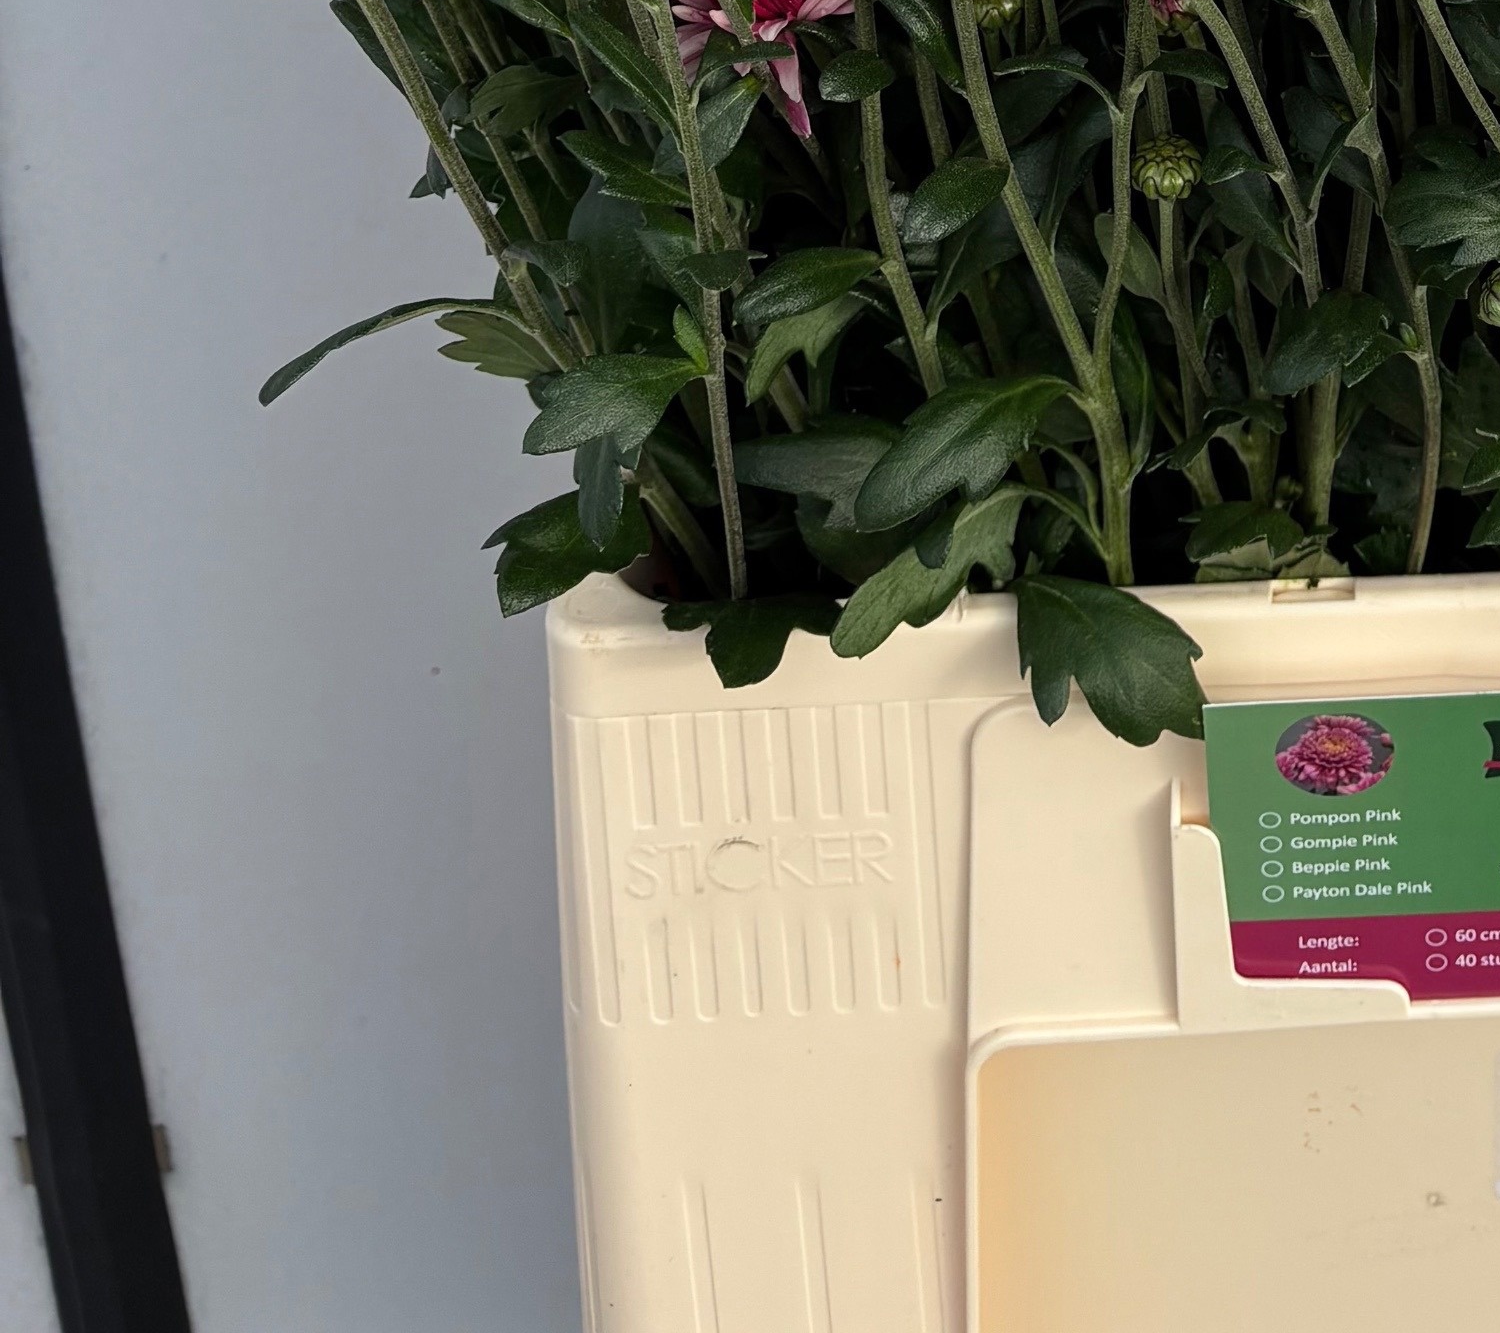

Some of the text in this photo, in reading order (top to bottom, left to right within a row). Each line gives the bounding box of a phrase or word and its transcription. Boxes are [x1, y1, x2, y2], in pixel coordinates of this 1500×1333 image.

[1290, 809, 1401, 826] Pompon Pink
[1290, 834, 1398, 851] Gompie Pink
[624, 831, 894, 900] STICKER
[1292, 858, 1391, 875] Beppie Pink
[1293, 881, 1433, 901] Payton Dale Pink
[1298, 935, 1360, 951] Lengte:
[1455, 929, 1477, 942] 60
[1299, 960, 1358, 974] Aantal:
[1455, 954, 1477, 967] 40
